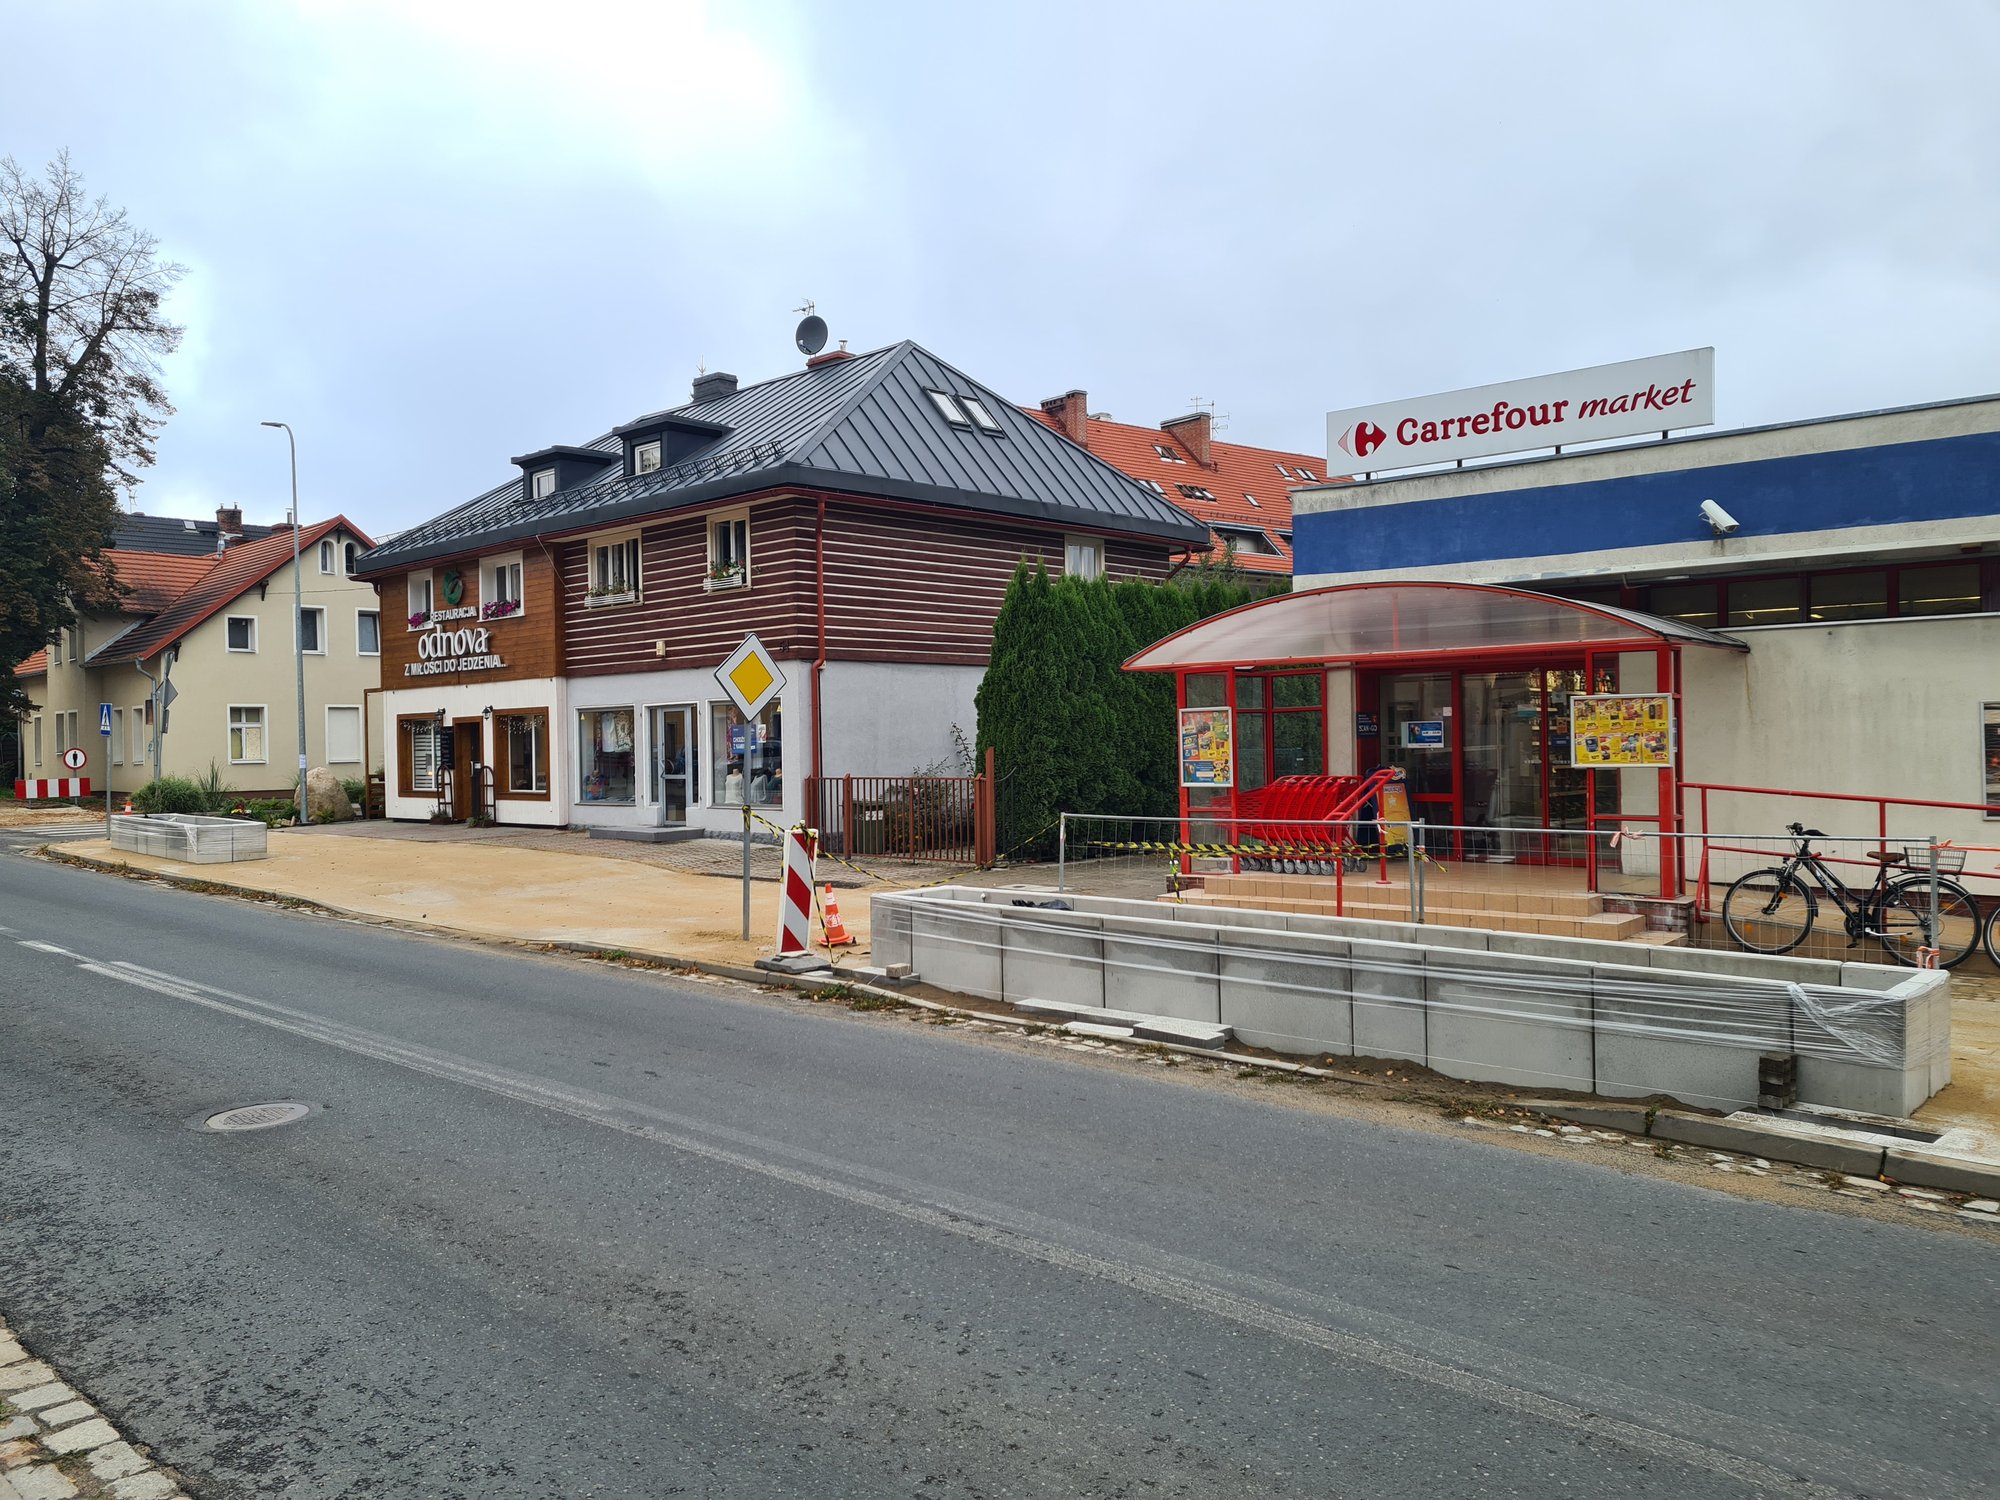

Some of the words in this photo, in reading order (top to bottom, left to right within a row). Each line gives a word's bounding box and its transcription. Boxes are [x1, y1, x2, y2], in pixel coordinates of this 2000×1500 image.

[1396, 399, 1568, 446] Carrefour
[1578, 378, 1697, 420] market
[430, 606, 477, 621] RESTAURACJA
[418, 624, 491, 659] odnova
[404, 663, 411, 676] Z
[411, 658, 442, 676] MIŁOŚCI
[444, 659, 457, 672] DO
